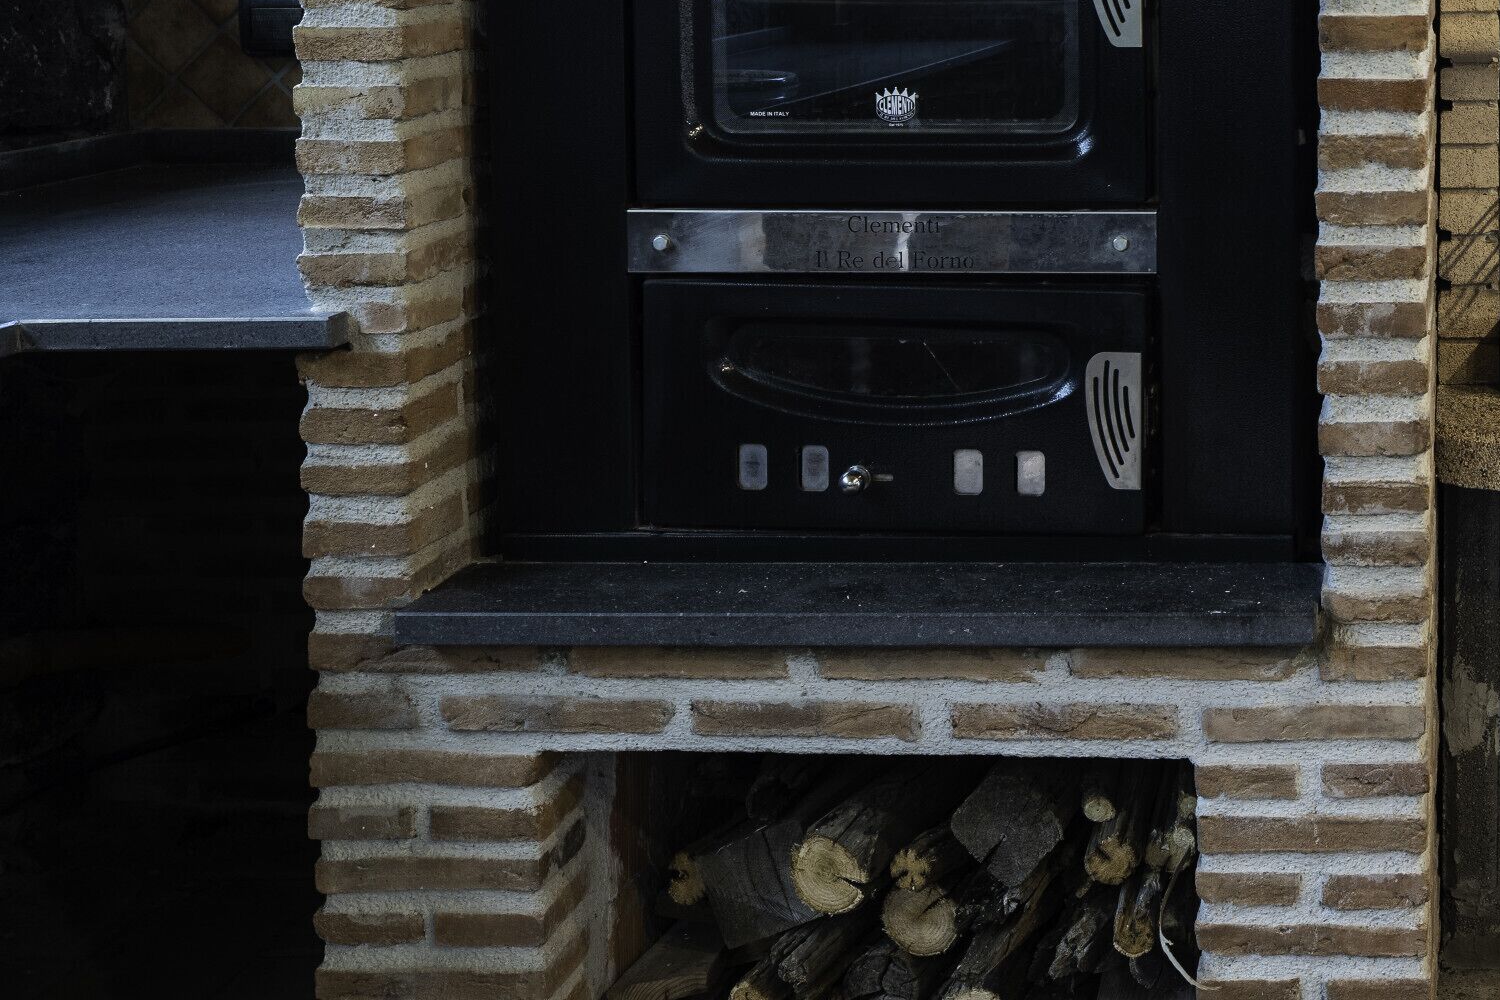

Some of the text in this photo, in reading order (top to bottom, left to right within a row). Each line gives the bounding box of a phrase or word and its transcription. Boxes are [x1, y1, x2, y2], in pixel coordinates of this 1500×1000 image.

[879, 95, 913, 115] CLEMENTI
[848, 216, 941, 234] Clementi
[838, 250, 864, 268] Re
[873, 251, 904, 268] del
[914, 251, 974, 269] Forno
